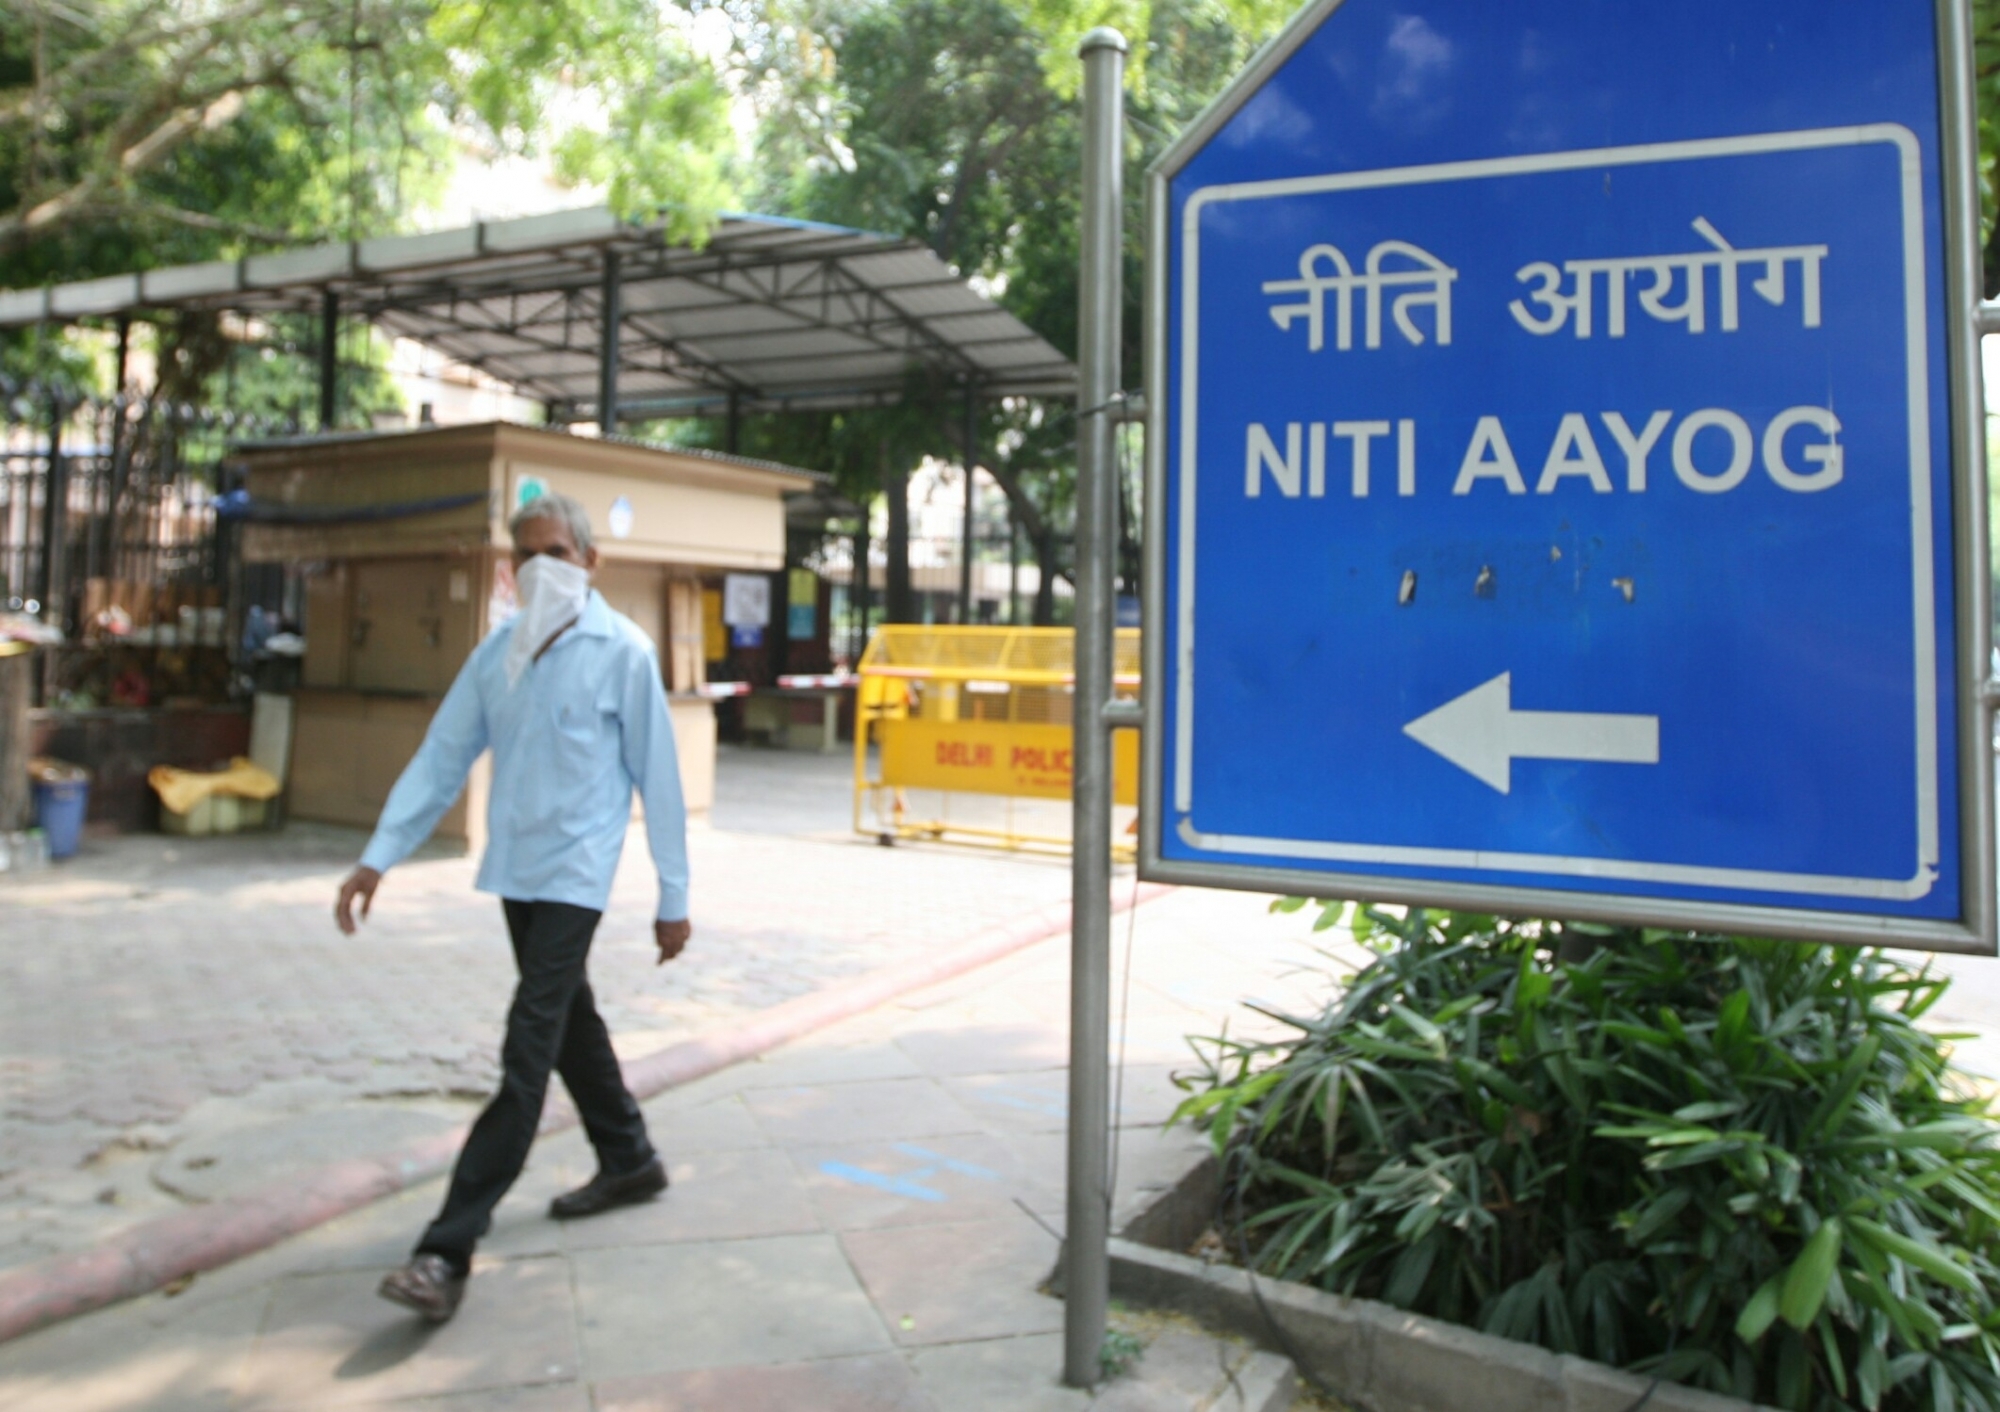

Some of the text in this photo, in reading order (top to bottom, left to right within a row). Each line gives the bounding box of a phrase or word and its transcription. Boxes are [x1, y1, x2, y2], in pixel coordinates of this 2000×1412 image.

[1262, 215, 1829, 352] नीति आयोग
[1244, 405, 1845, 498] NITI AAYOG
[936, 741, 1073, 774] DELHI POLIC
